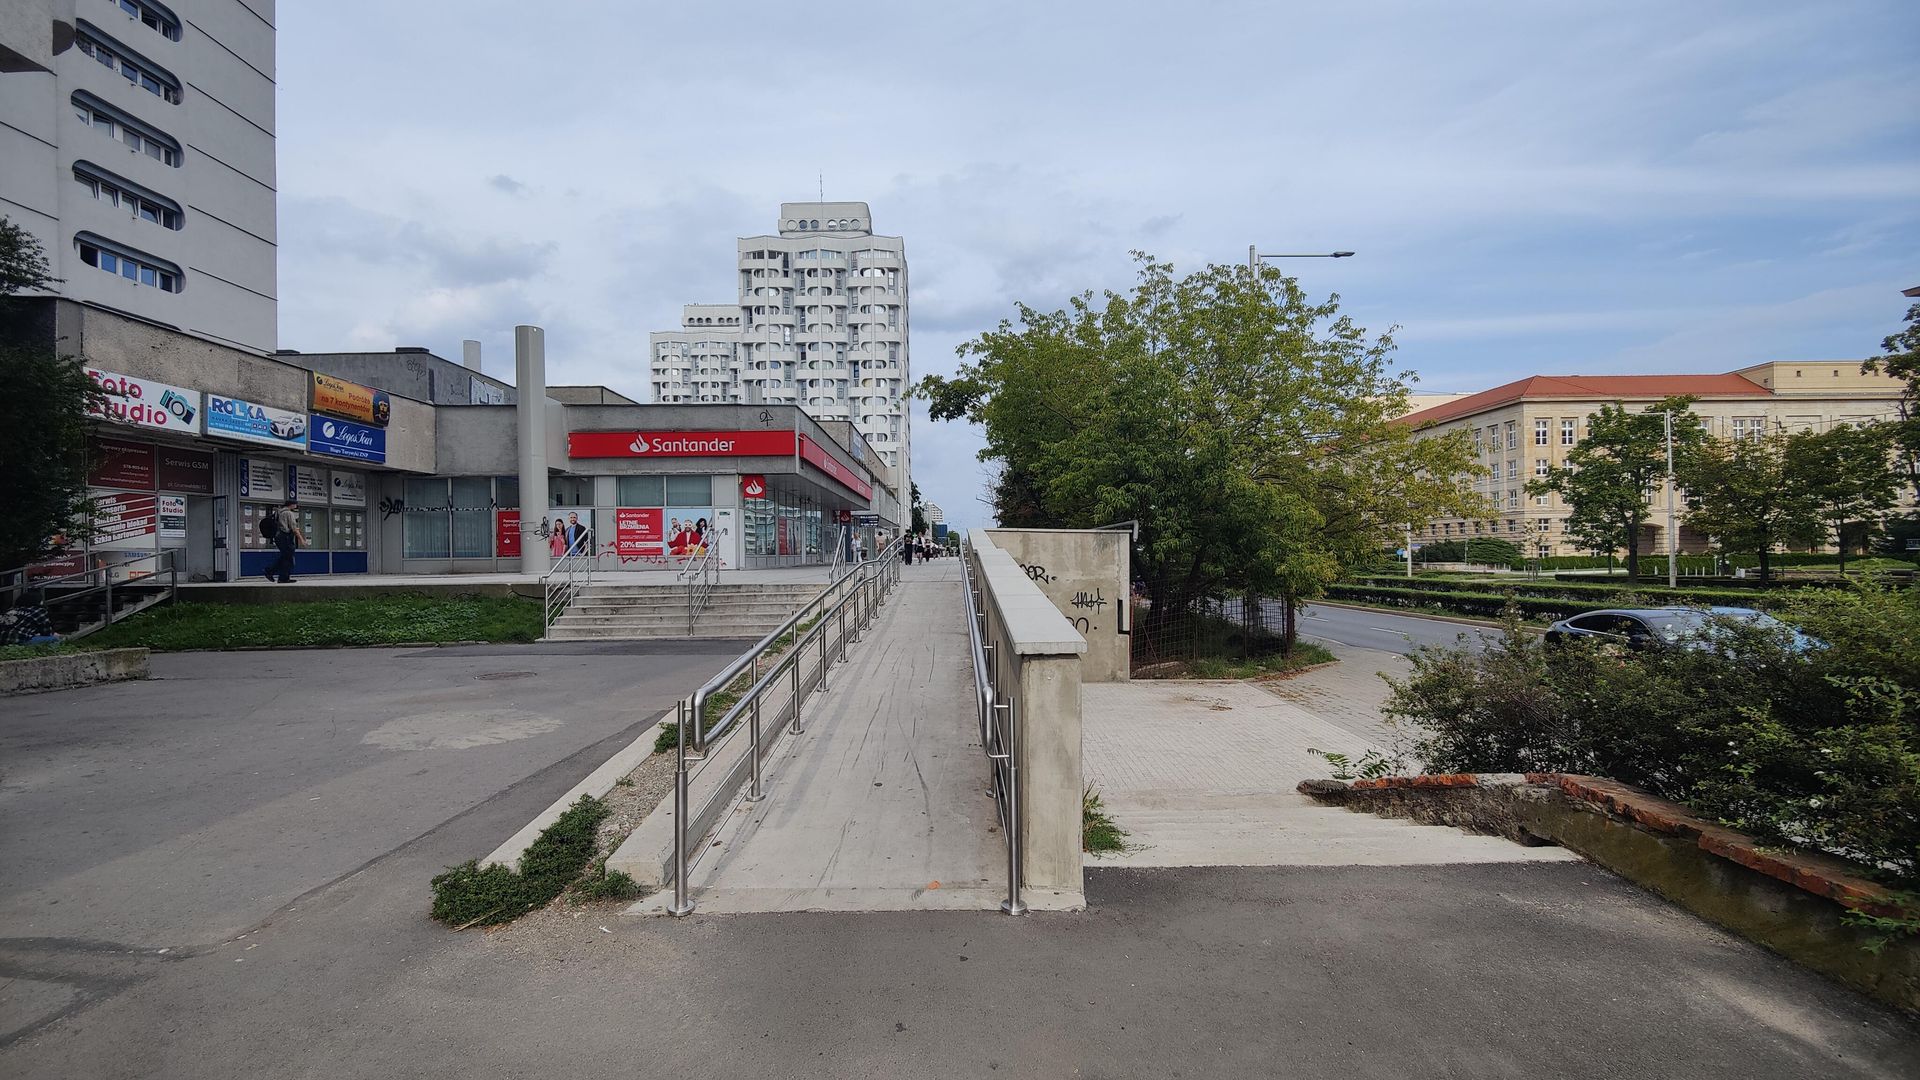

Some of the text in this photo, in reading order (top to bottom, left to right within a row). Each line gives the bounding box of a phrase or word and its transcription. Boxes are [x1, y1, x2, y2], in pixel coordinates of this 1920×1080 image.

[212, 397, 267, 421] ROLKA
[652, 437, 735, 453] Santander
[165, 457, 209, 470] Serwis GSM
